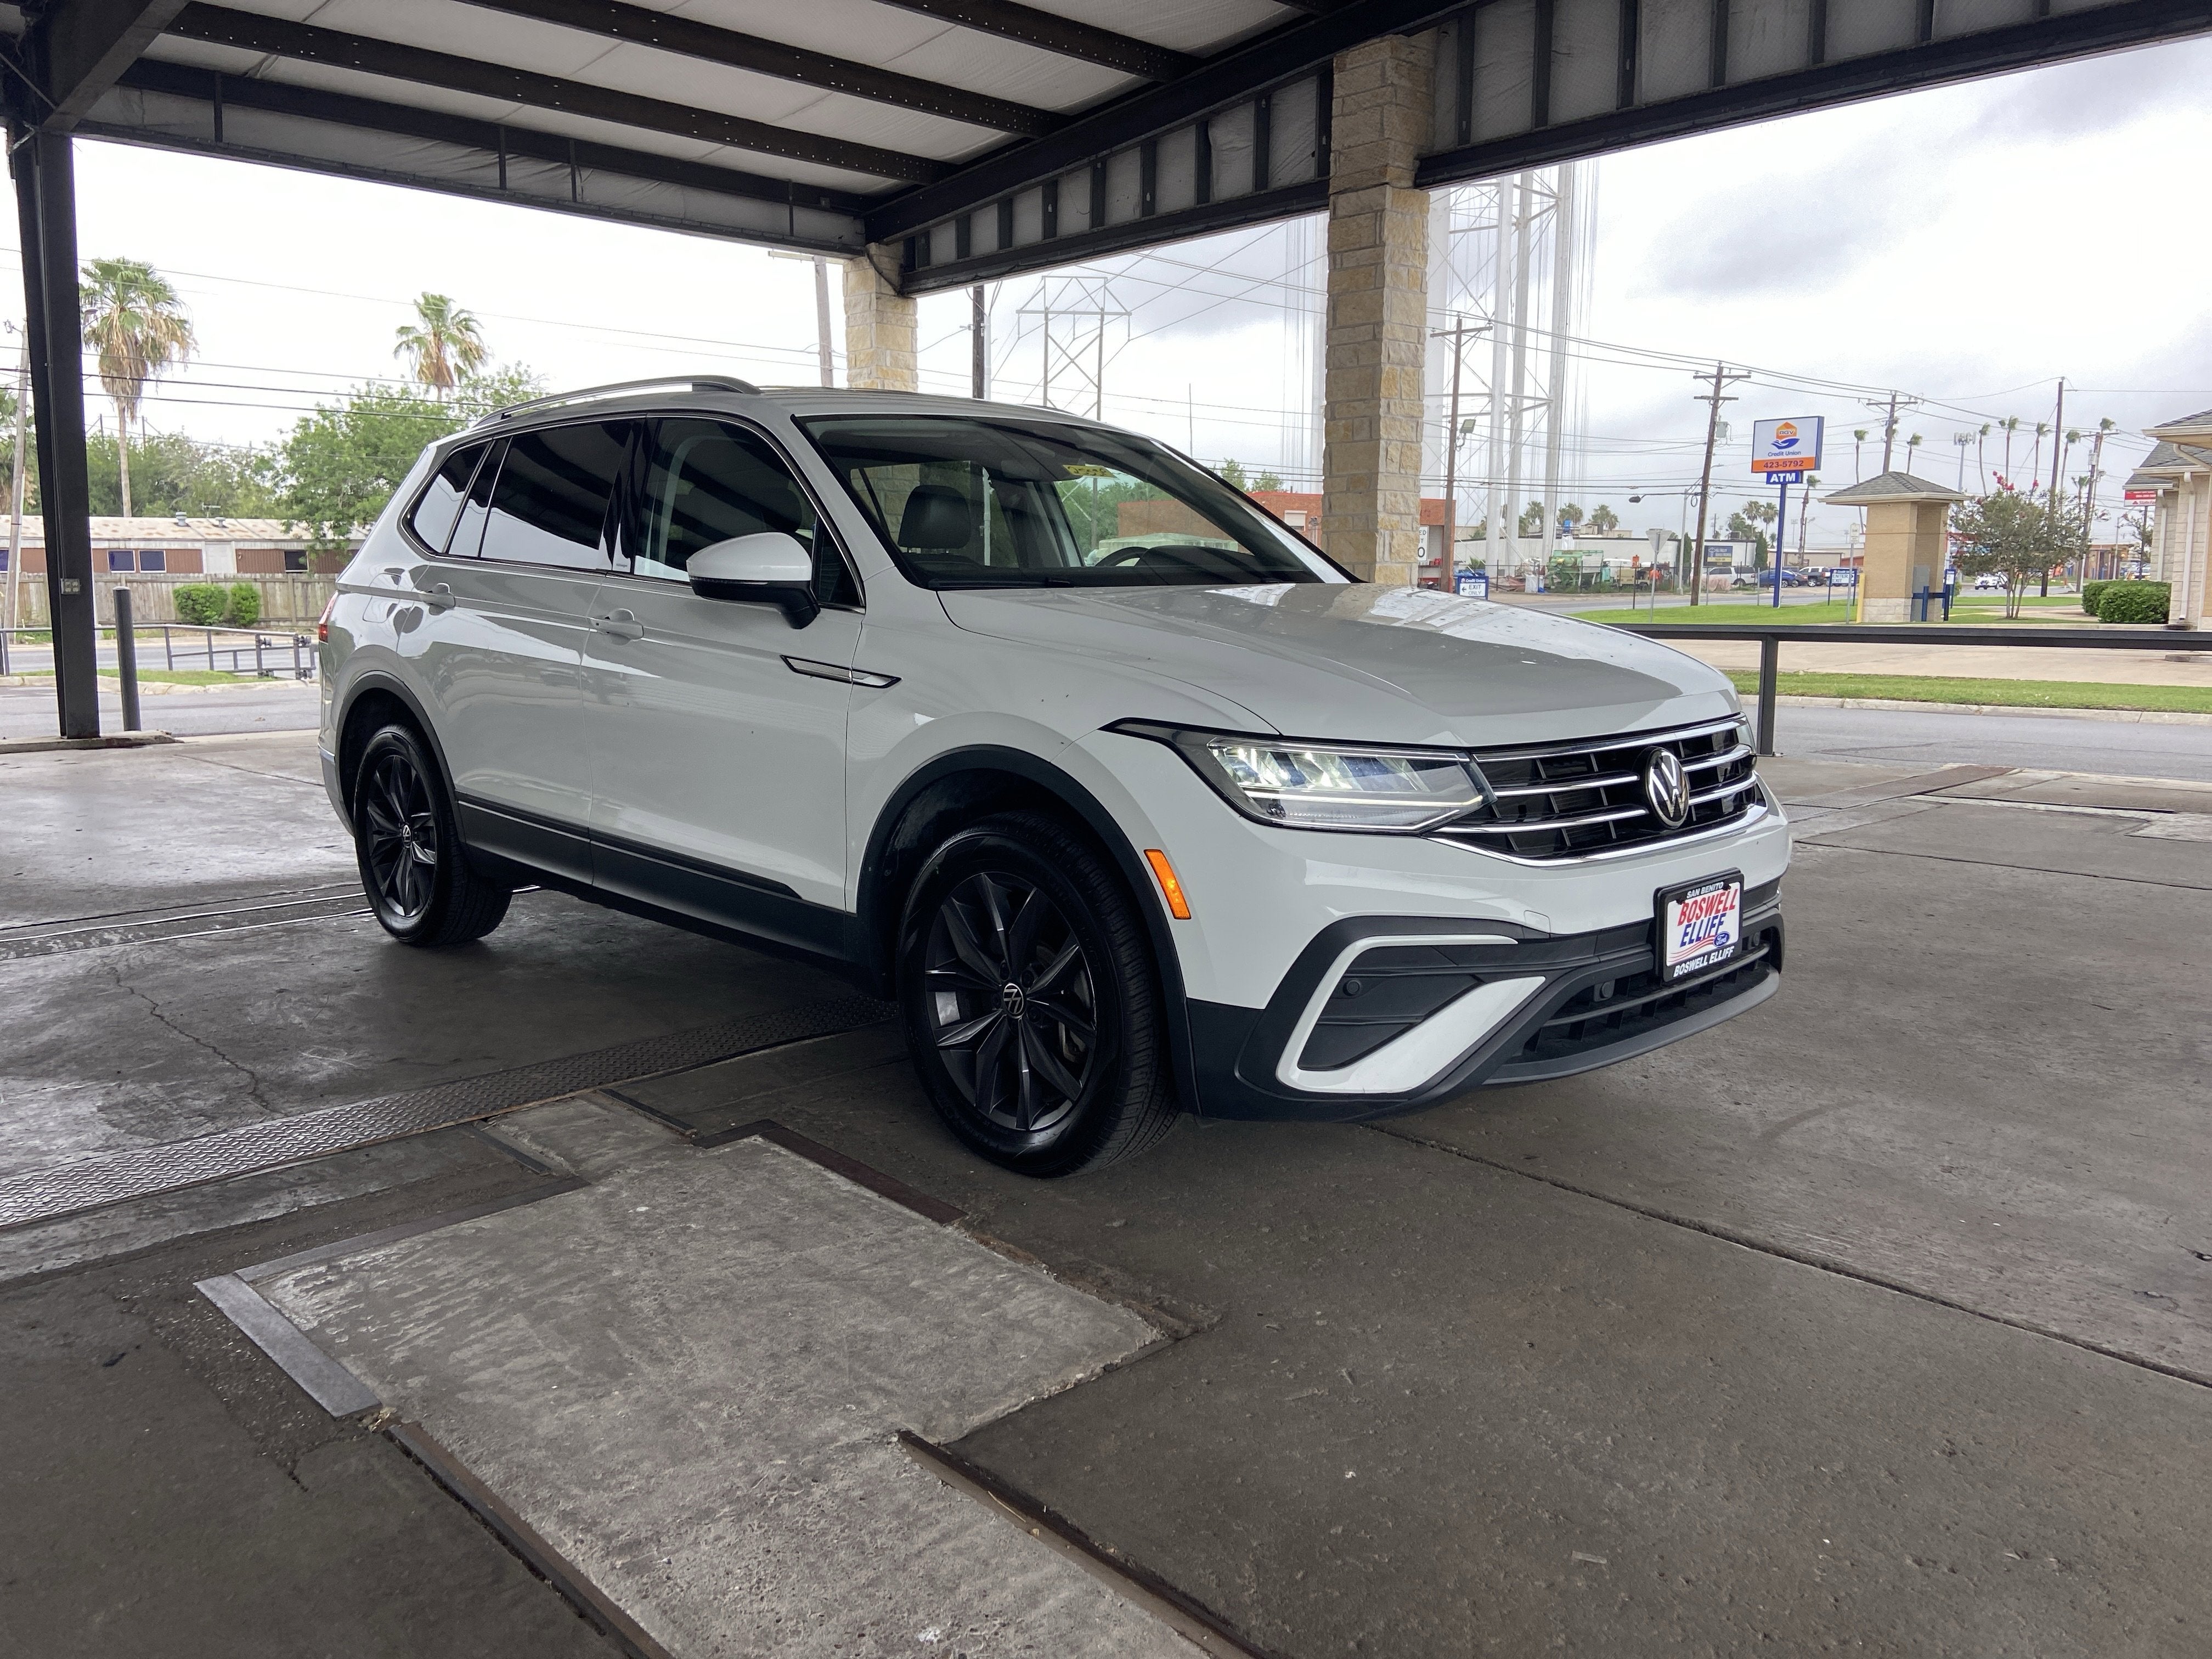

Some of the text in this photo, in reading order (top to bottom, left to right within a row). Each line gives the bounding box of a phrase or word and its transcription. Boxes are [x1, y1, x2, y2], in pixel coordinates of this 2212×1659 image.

[1763, 460, 1804, 469] 423-5792
[1770, 472, 1796, 483] ATM
[1686, 882, 1724, 900] SAN BENITO
[1677, 888, 1739, 927] BOSWELL
[1679, 912, 1726, 948] ELLIFF
[1673, 946, 1735, 978] BOSWELL ELLIFF
